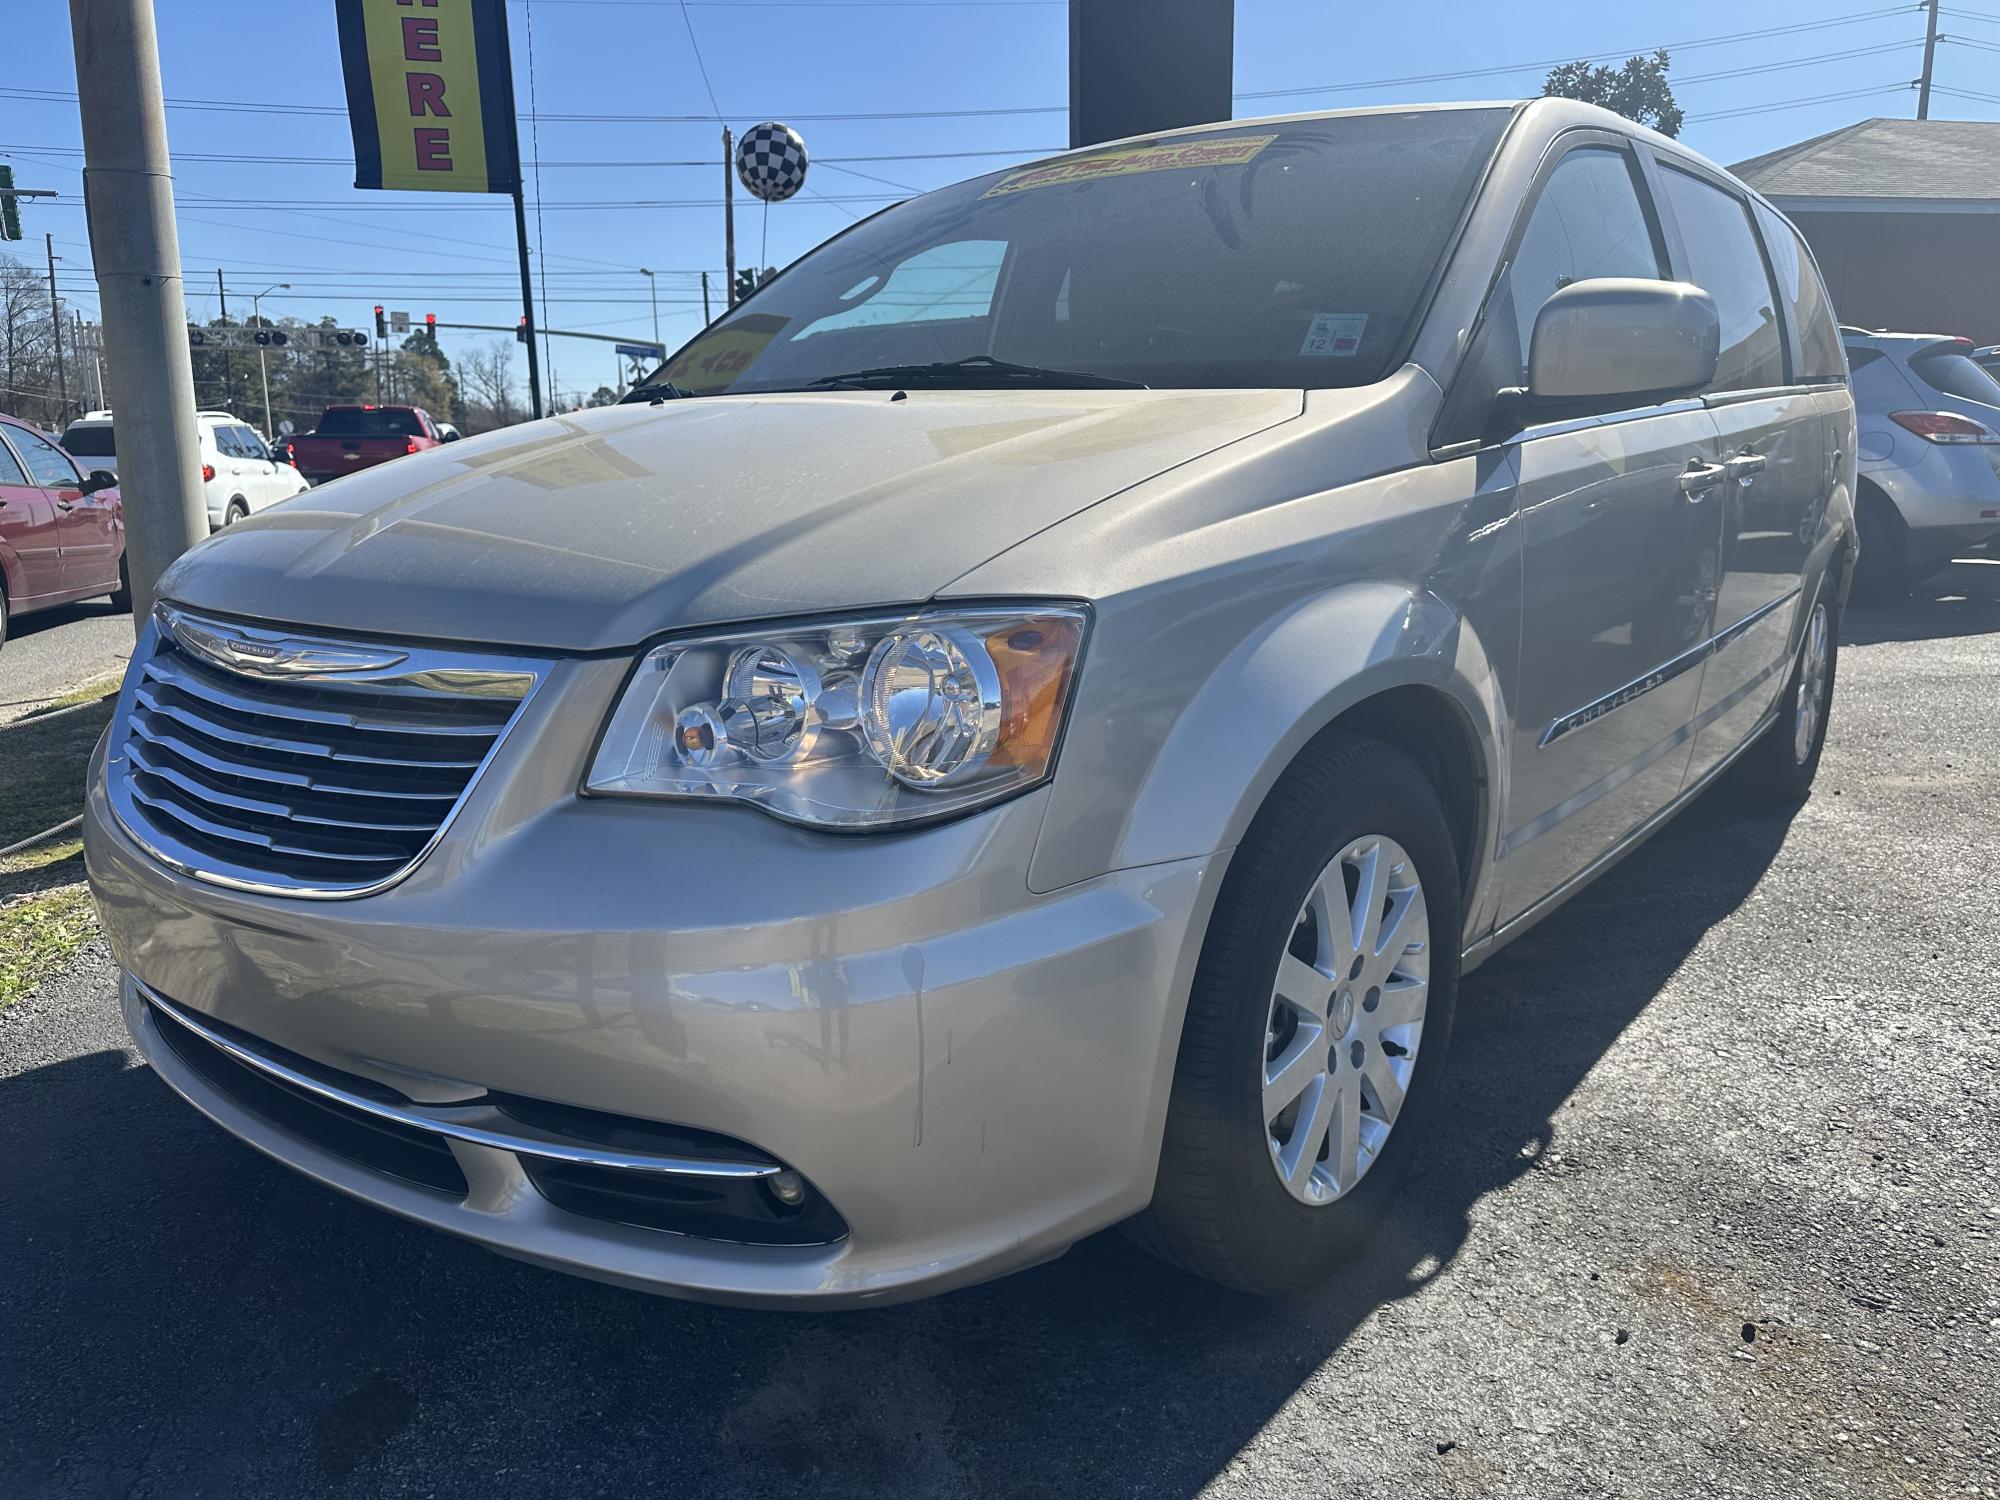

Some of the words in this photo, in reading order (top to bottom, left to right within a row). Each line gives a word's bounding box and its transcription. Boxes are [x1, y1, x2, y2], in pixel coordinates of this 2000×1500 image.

[397, 0, 453, 171] ERE
[1308, 338, 1326, 350] 12
[231, 643, 275, 655] CHRYSLER
[1568, 673, 1664, 729] CHRYSLER
